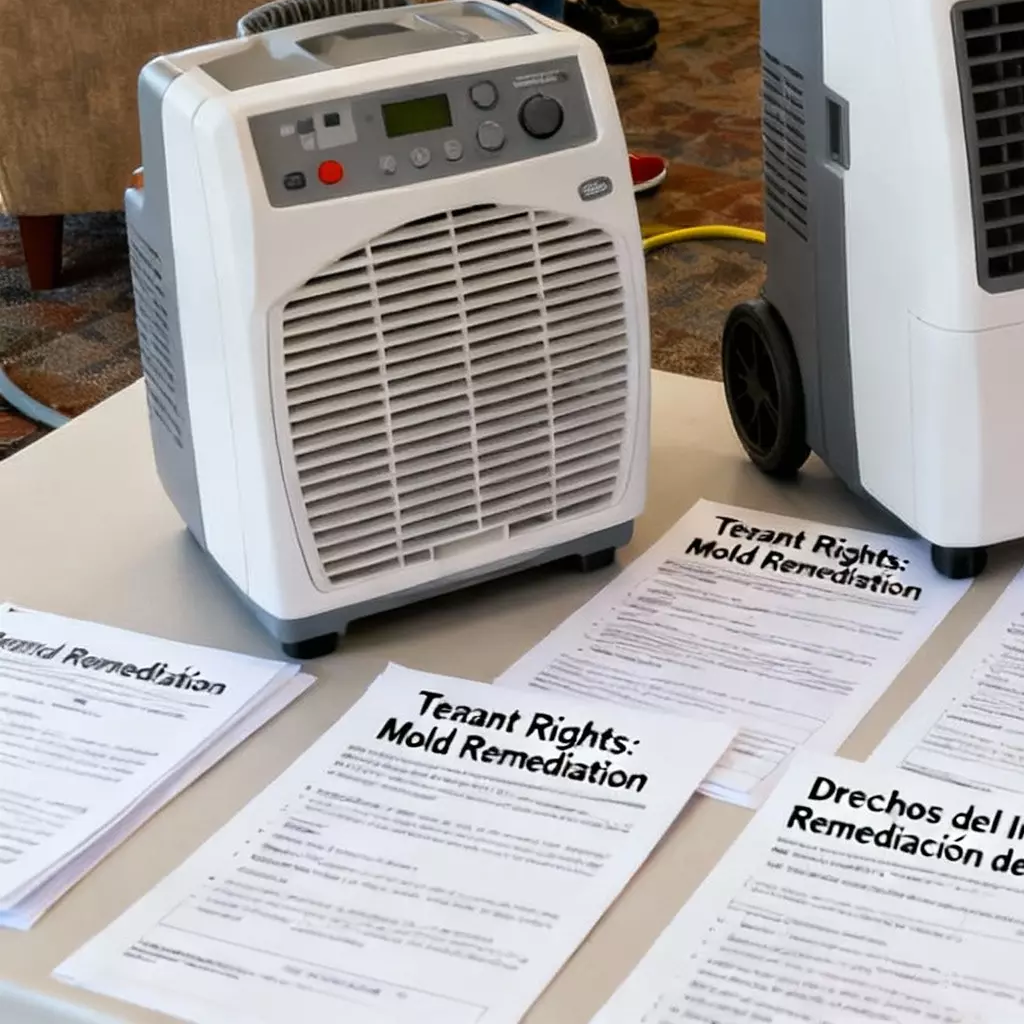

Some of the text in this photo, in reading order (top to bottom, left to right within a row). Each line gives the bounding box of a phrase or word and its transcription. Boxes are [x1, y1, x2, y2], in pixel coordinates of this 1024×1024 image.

[684, 537, 760, 567] Mold
[811, 533, 911, 573] Rights:
[376, 717, 649, 794] Mold Remediation
[525, 712, 641, 756] Rights:
[807, 776, 944, 825] Drechos
[950, 805, 1003, 835] del
[786, 805, 985, 869] Remediación
